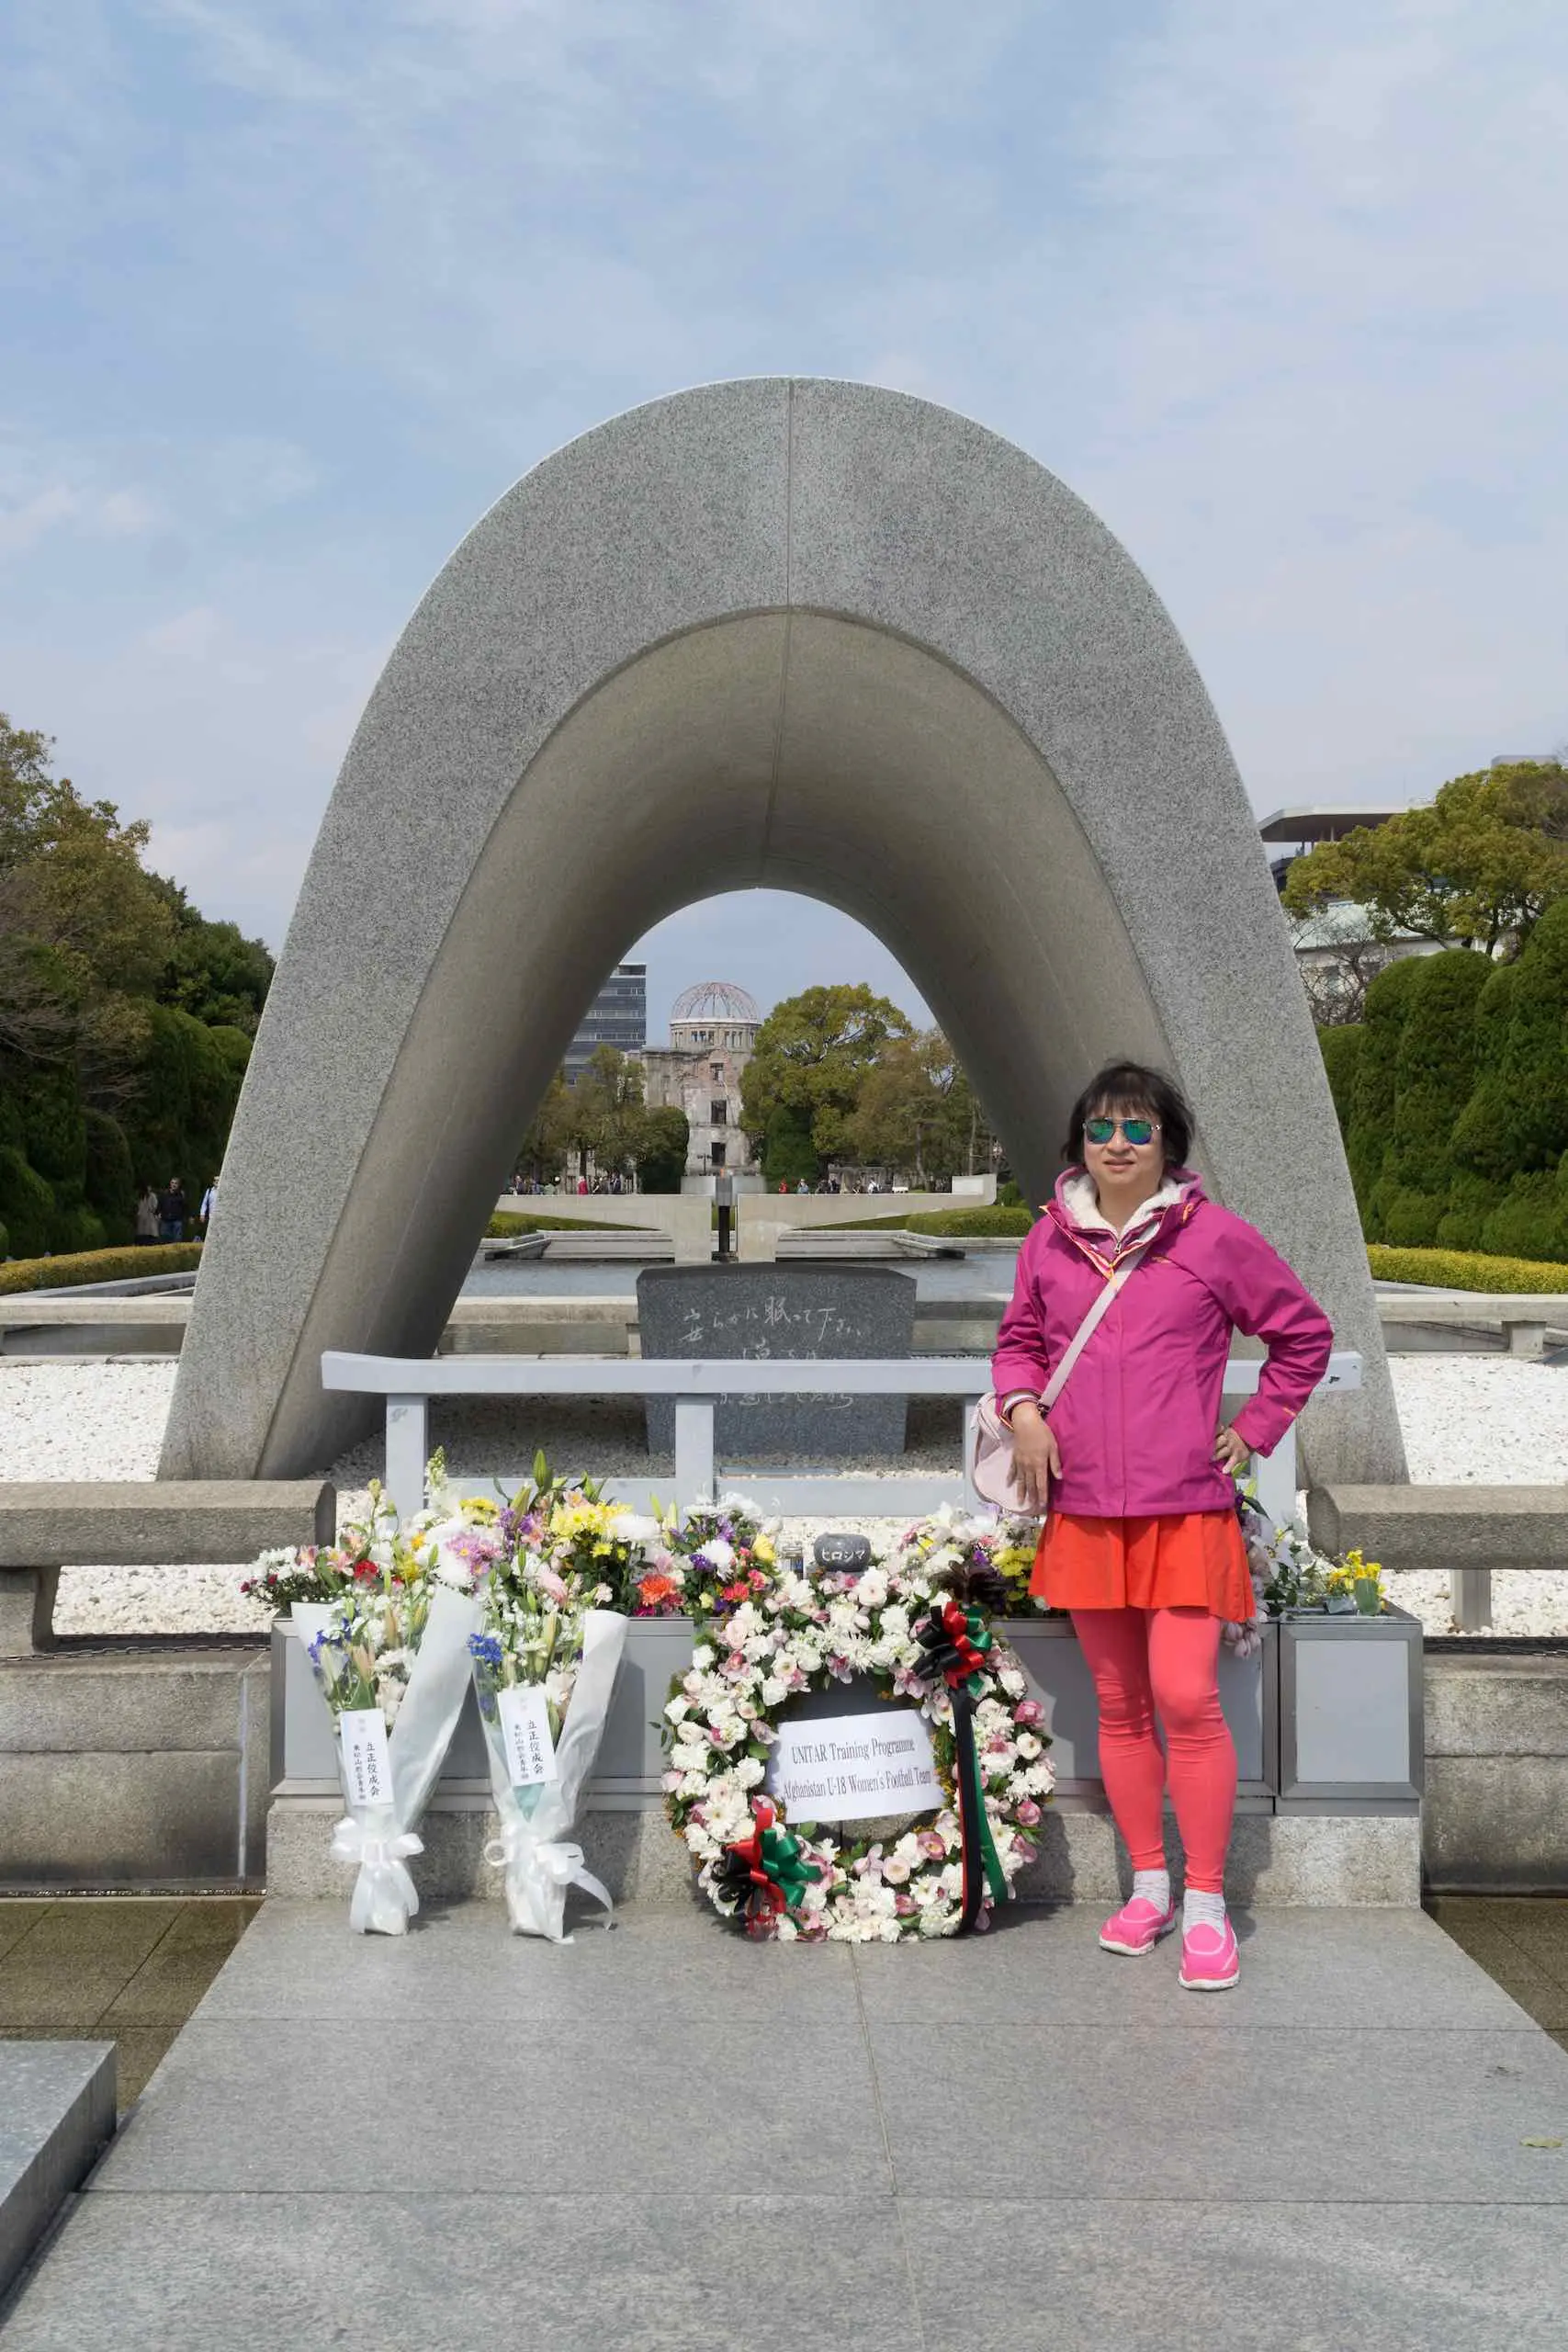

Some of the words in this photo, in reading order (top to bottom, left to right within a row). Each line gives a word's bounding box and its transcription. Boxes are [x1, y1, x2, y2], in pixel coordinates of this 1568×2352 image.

[821, 1547, 865, 1562] ヒロシマ
[793, 1744, 828, 1764] UNITAR
[829, 1741, 870, 1760] Training
[872, 1737, 915, 1757] Programme
[784, 1780, 826, 1802] Afghanistan
[827, 1775, 847, 1796] U-18
[848, 1771, 885, 1792] Women's
[886, 1768, 914, 1789] Football
[915, 1767, 931, 1785] Team
